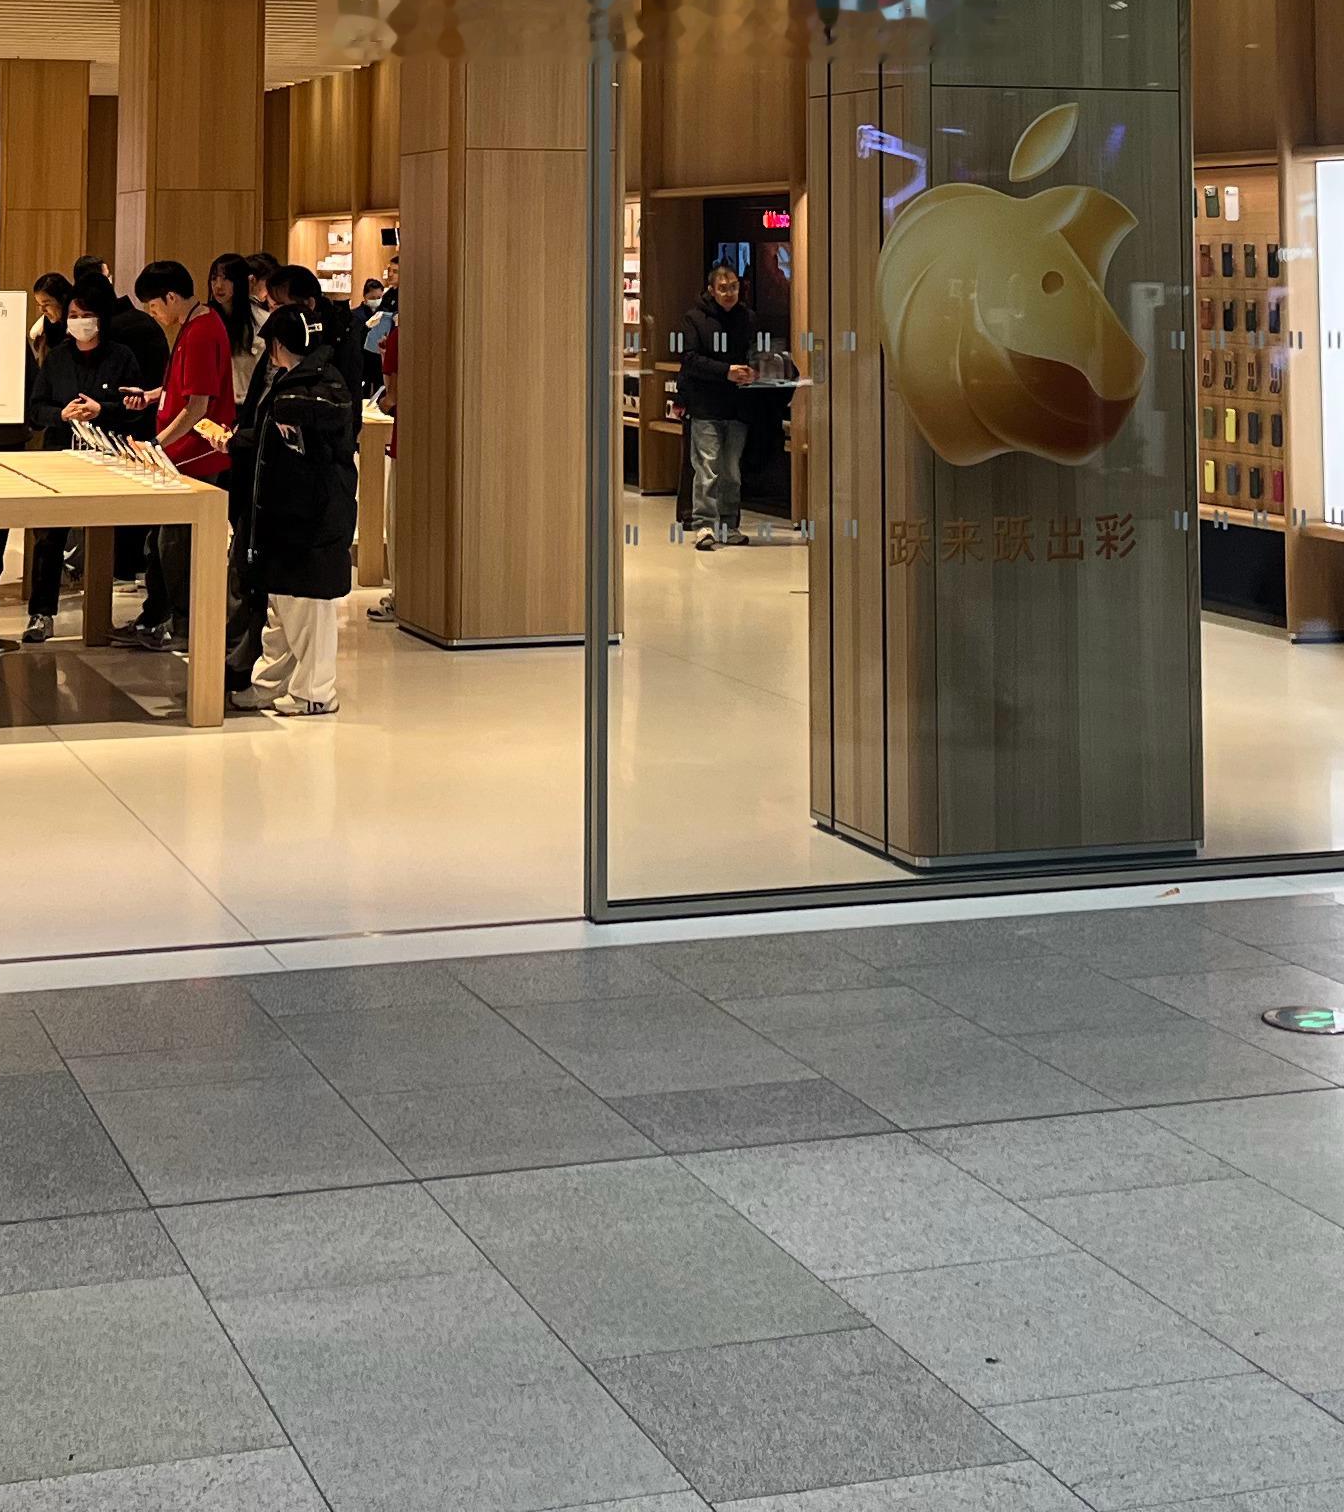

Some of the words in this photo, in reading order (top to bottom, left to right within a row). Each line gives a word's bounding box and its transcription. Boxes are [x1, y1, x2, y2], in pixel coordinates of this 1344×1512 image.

[888, 513, 1137, 567] 跃来跃出彩
